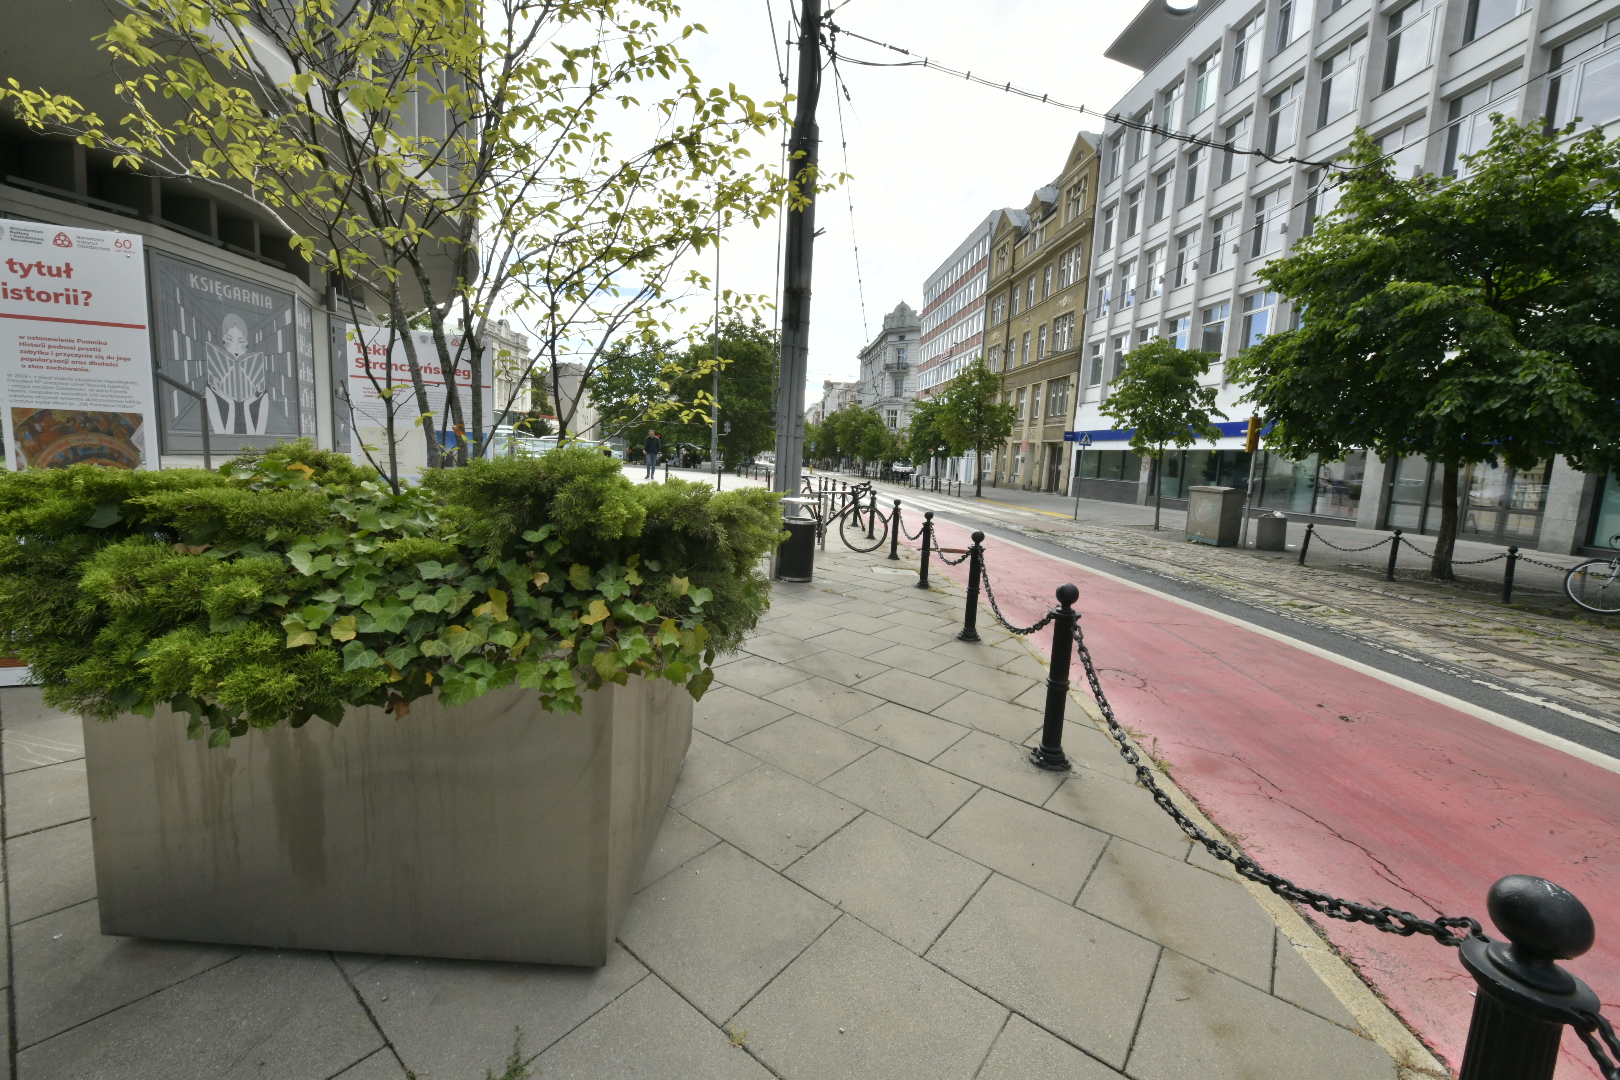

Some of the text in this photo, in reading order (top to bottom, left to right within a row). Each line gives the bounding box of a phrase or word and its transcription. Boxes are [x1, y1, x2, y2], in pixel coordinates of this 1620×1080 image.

[114, 238, 132, 249] 60
[5, 258, 74, 279] tytuł
[1, 281, 93, 307] istorii?
[189, 273, 273, 310] KSIĘGARNIA
[18, 341, 46, 349] Historii
[47, 343, 76, 352] podnosi
[77, 338, 108, 346] Pomnika
[19, 348, 49, 356] zabytku
[55, 351, 93, 360] przyczynia
[20, 356, 69, 364] popularyzacji
